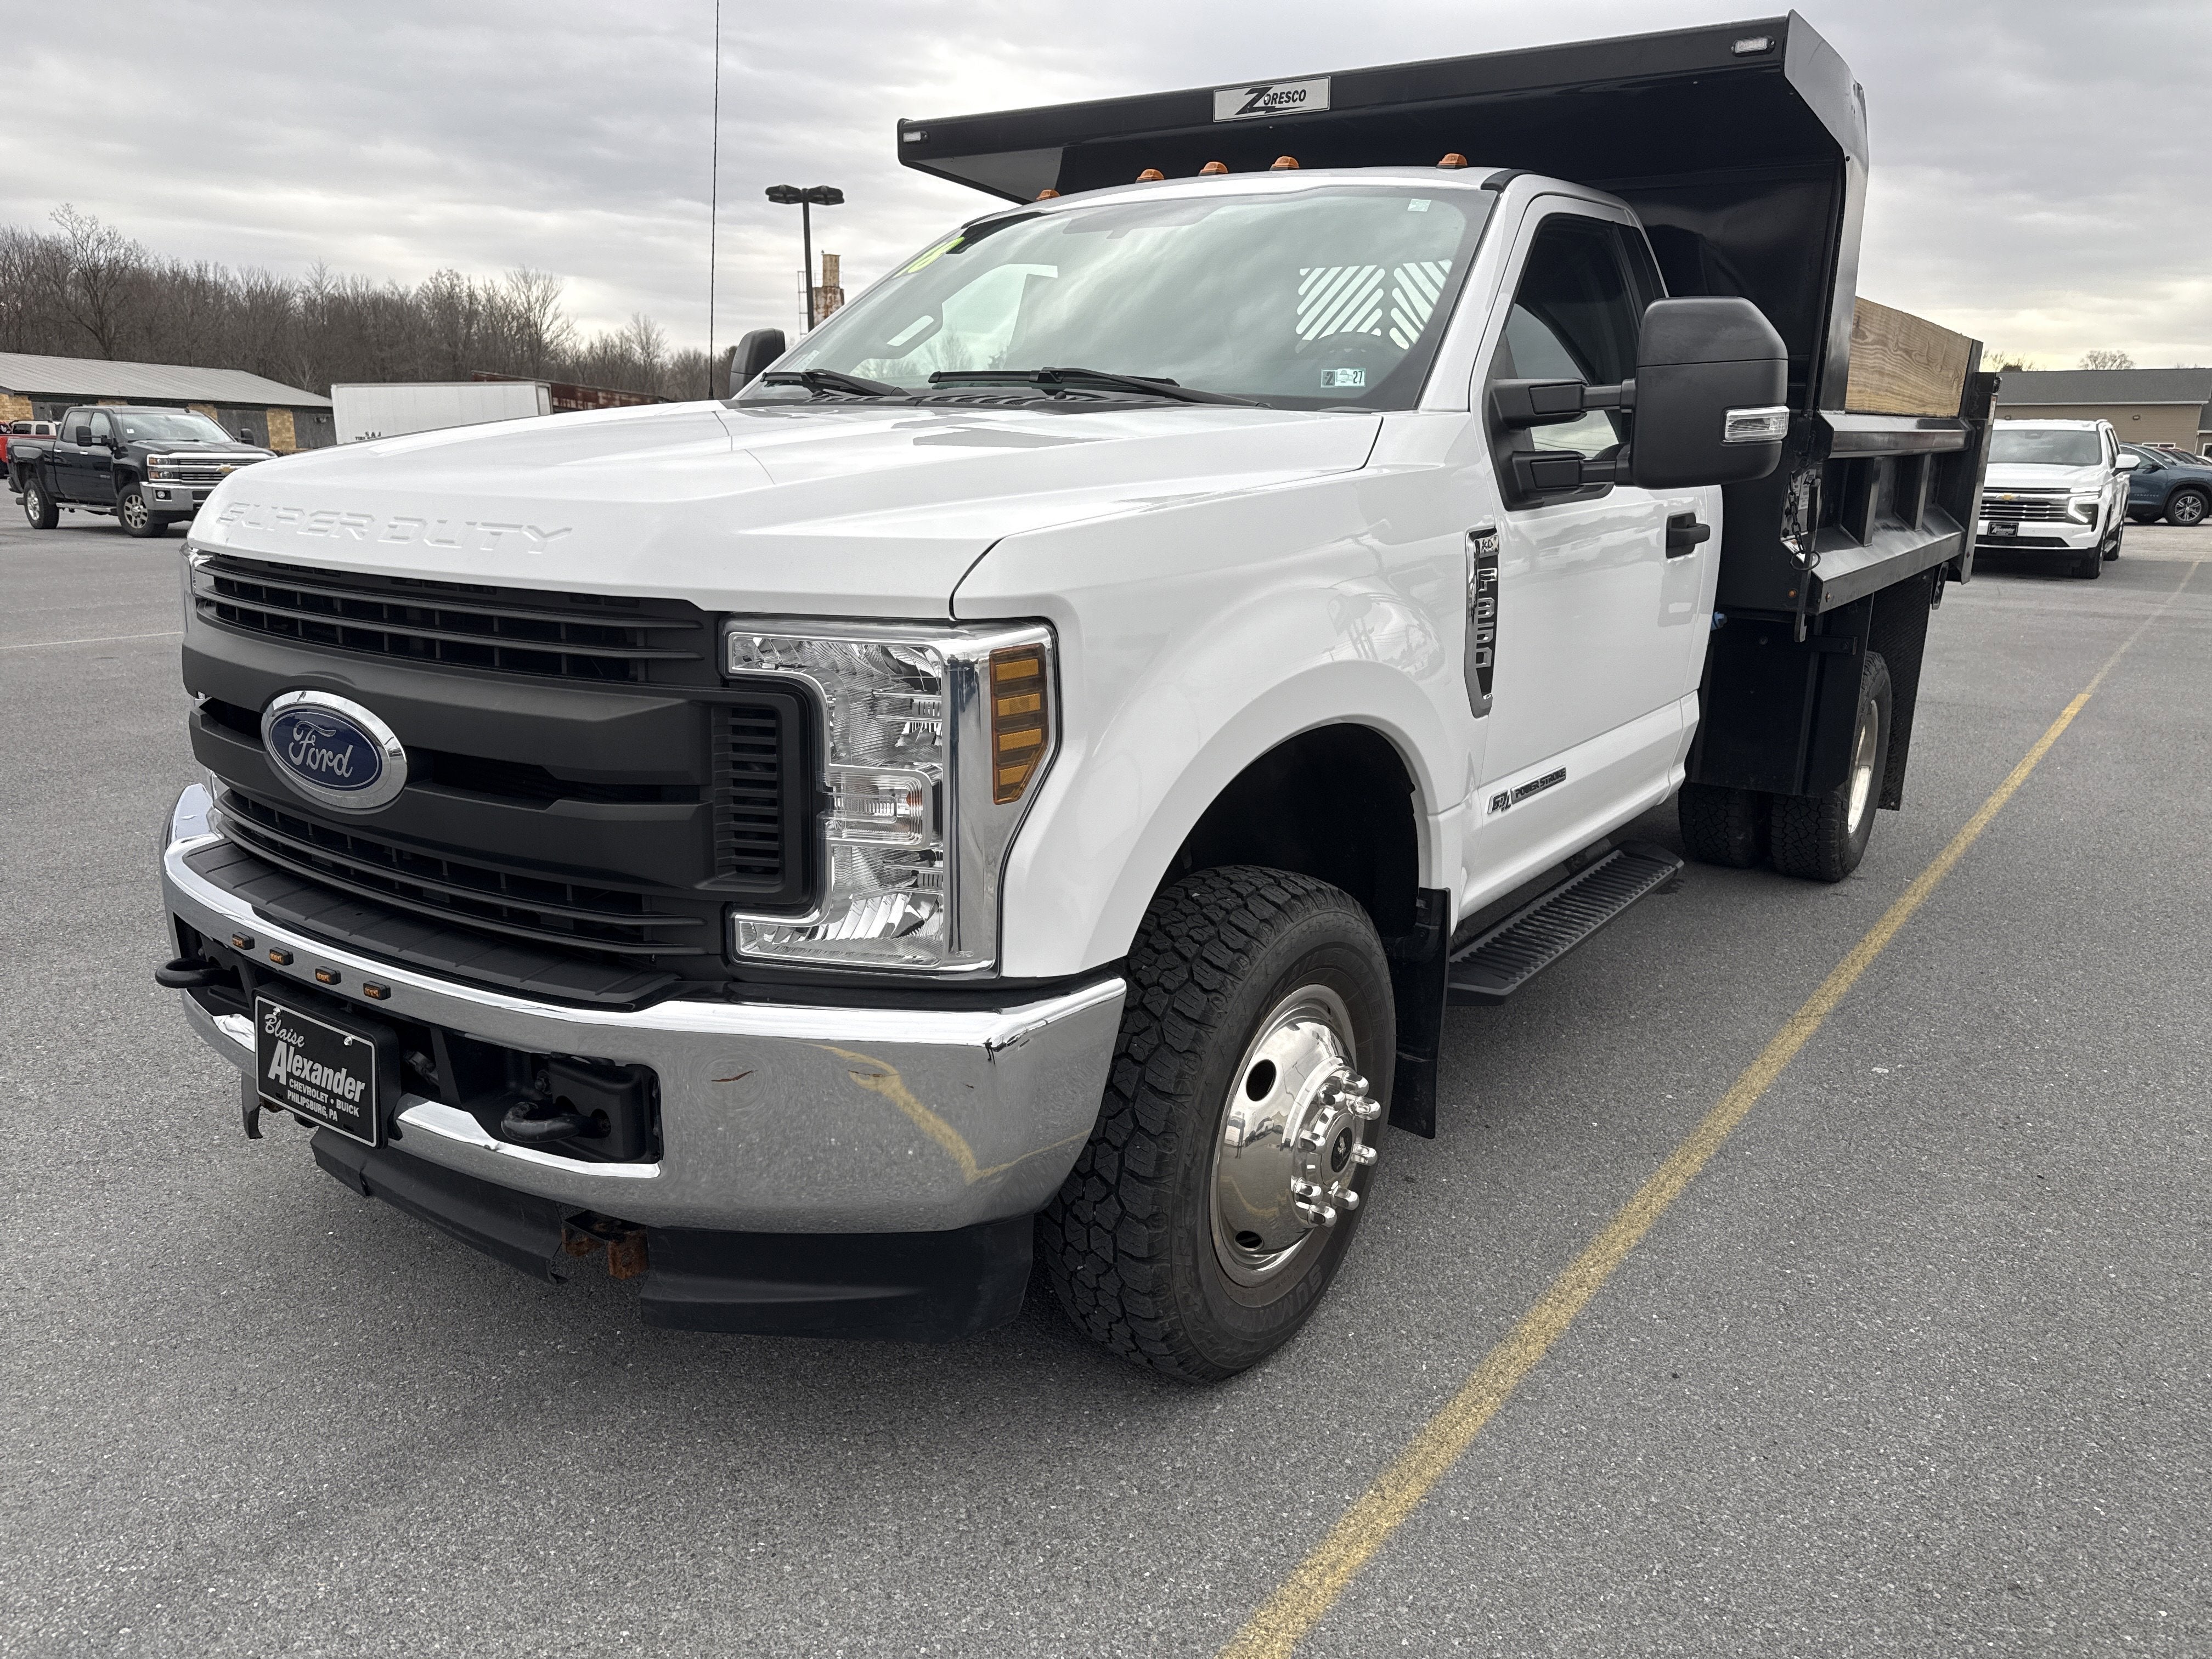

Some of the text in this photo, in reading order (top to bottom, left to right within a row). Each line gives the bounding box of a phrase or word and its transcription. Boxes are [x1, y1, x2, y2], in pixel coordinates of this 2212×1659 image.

[1234, 86, 1307, 115] ZORESCO
[1353, 370, 1363, 384] 27
[217, 502, 573, 554] SUPER DUTY
[288, 720, 354, 778] Ford
[1515, 780, 1539, 799] POWER
[264, 1013, 305, 1047] Blaise
[268, 1040, 365, 1103] Alexander
[287, 1090, 338, 1122] PHILIPSBURG, PA
[289, 1078, 360, 1118] CHEVROLET BUICK
